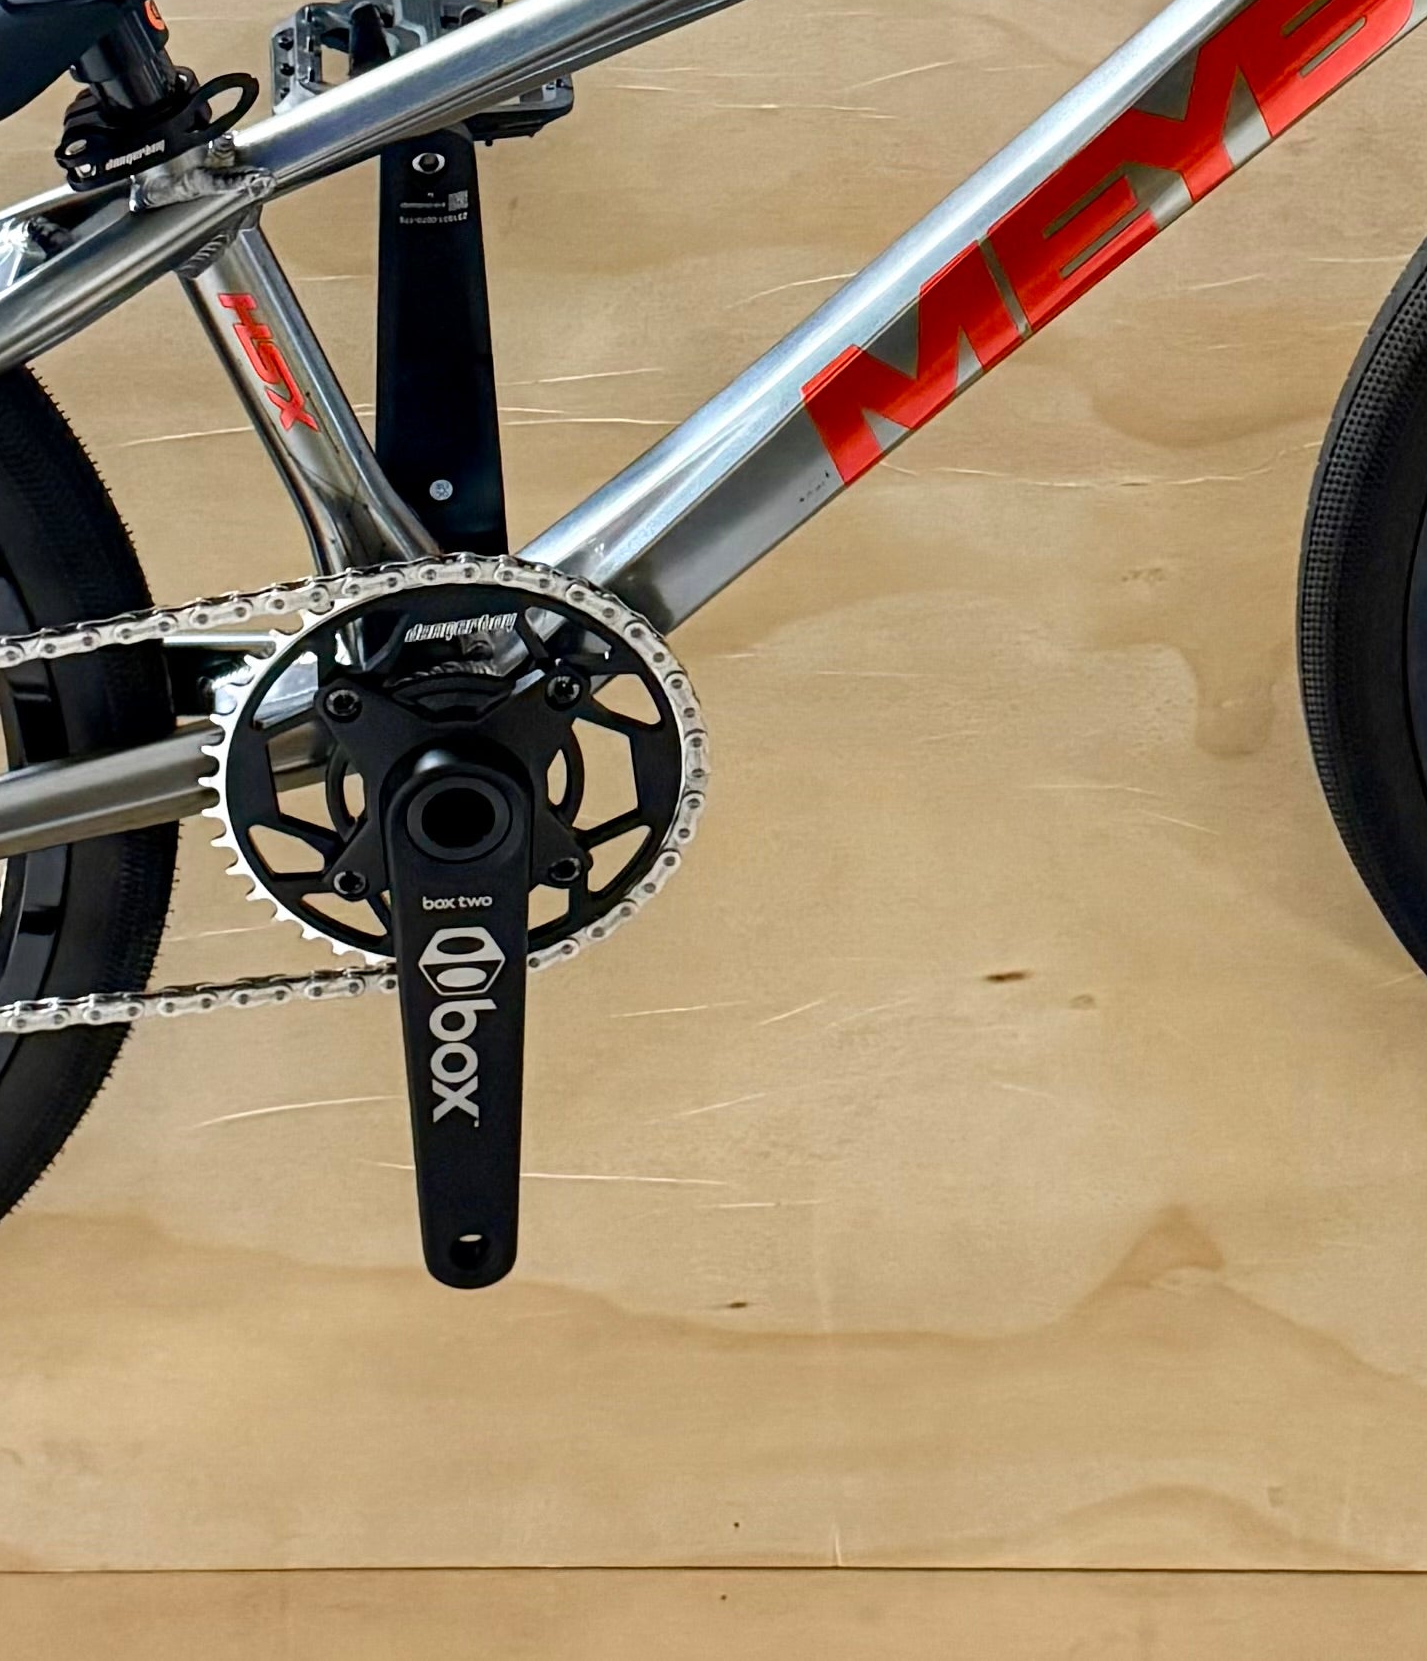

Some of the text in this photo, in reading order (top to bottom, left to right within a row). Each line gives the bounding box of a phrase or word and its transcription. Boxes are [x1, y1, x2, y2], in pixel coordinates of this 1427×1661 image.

[422, 895, 493, 910] box two
[429, 996, 497, 1123] box
